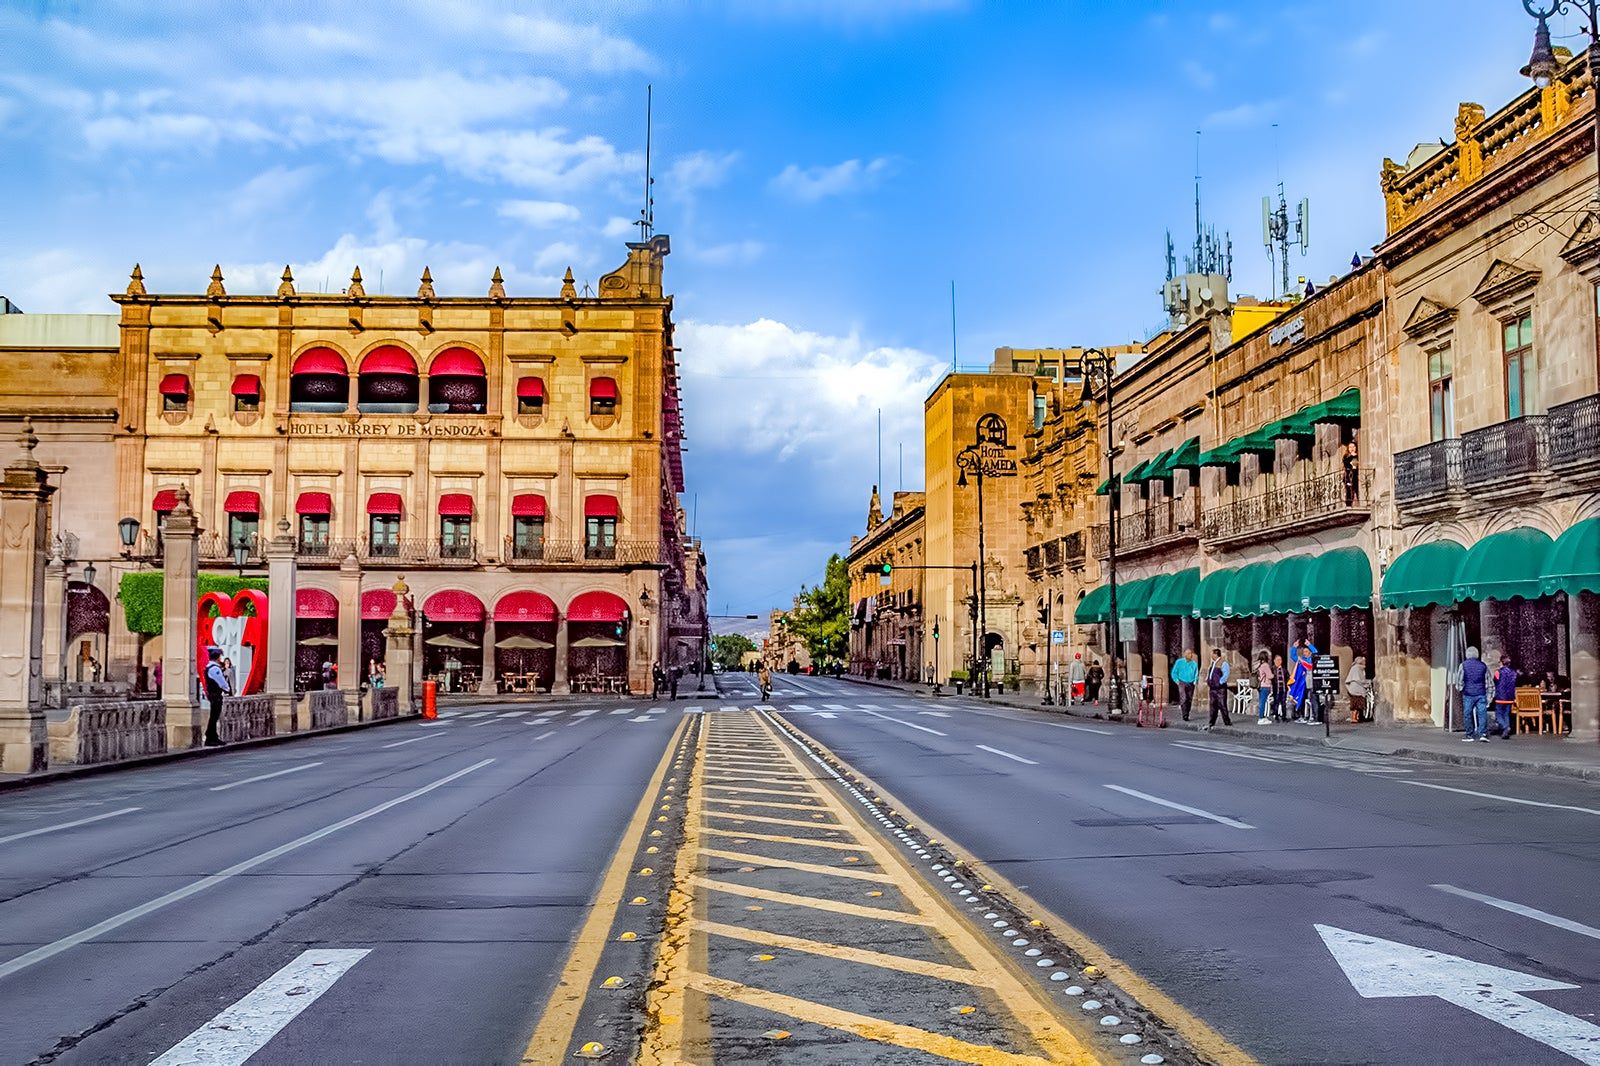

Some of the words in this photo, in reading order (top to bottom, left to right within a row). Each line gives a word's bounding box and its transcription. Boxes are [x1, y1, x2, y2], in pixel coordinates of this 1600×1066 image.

[290, 424, 332, 434] HOTEL
[398, 425, 416, 435] DE
[421, 425, 484, 436] MENDOZA
[981, 446, 1005, 457] HOTEL
[967, 455, 1017, 470] AAMEDA
